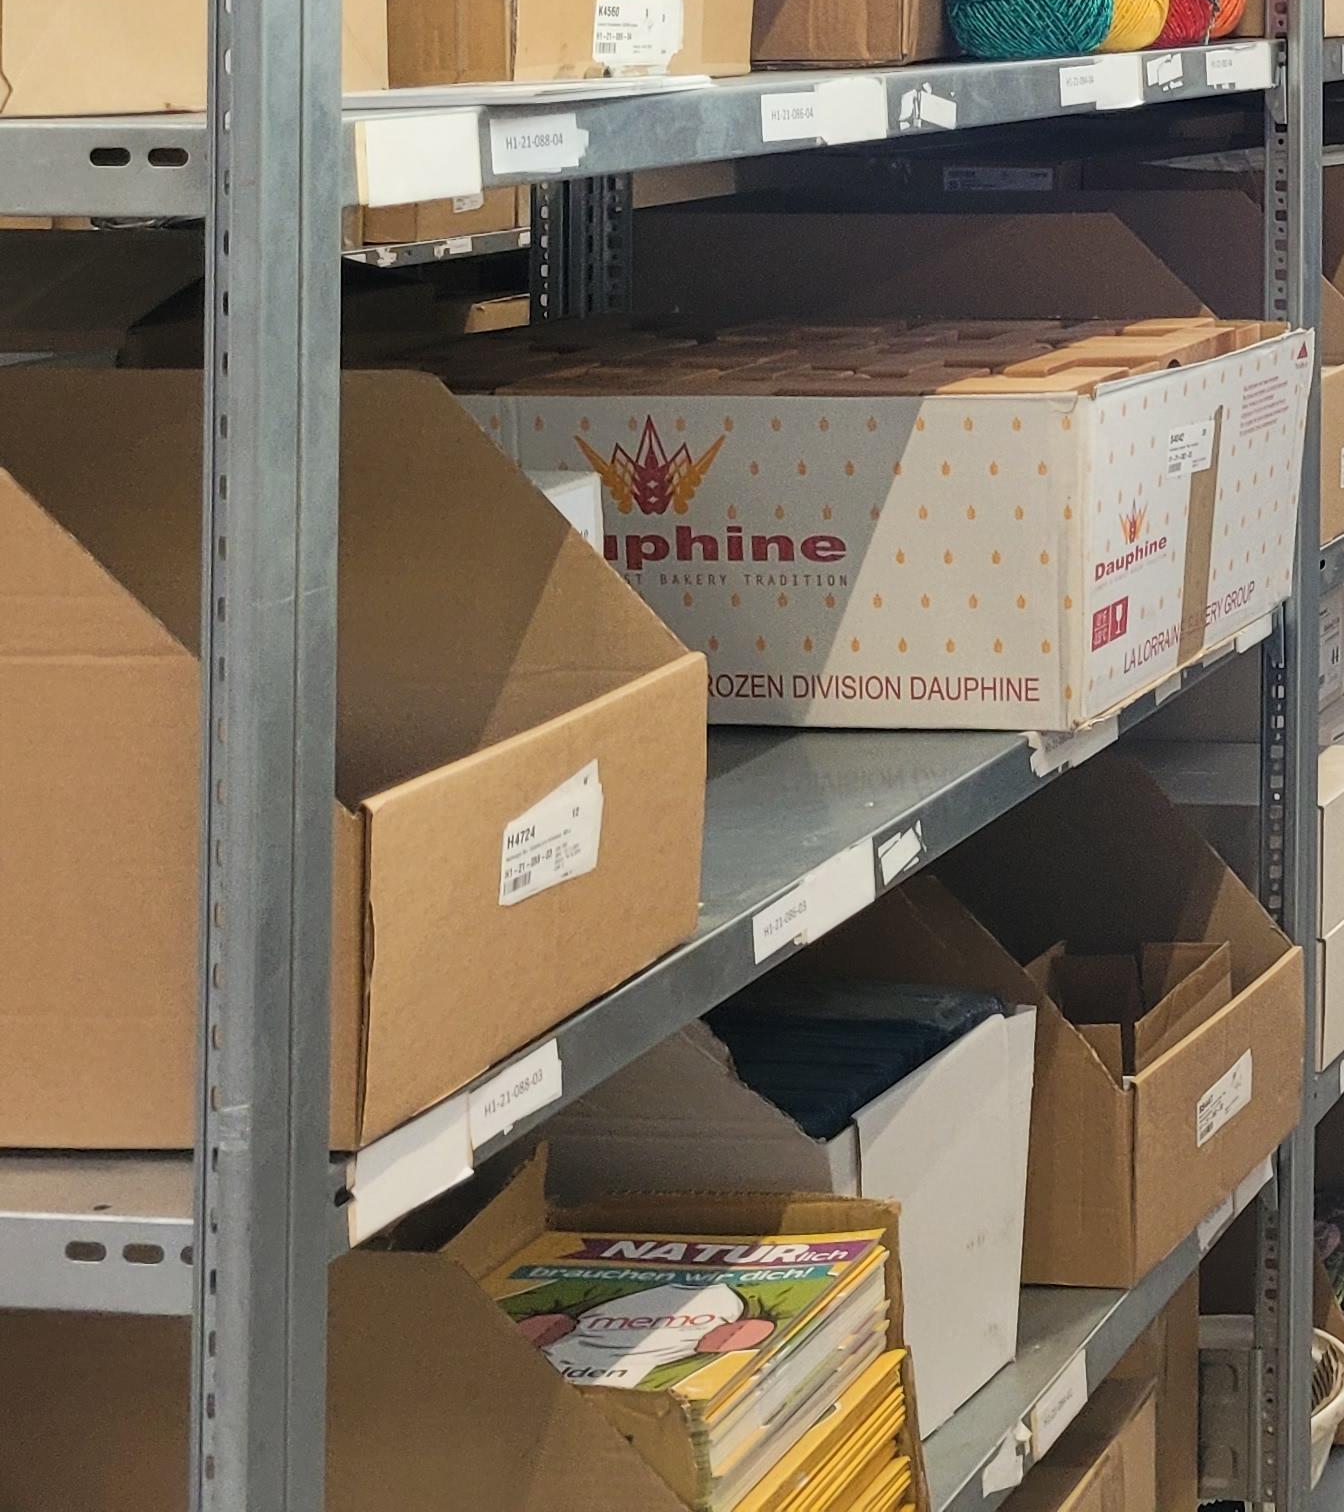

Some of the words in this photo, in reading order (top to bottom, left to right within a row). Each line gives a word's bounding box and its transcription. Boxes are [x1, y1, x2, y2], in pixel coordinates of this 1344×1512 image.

[504, 131, 565, 152] H1-21-088-04
[1093, 534, 1169, 582] Dauphine
[660, 573, 728, 586] BAKERY
[743, 573, 849, 587] TRADITION
[1223, 579, 1257, 618] GROUP
[792, 674, 902, 701] DIVISION
[909, 675, 1041, 703] DAUPHINE
[506, 824, 537, 850] H4724
[483, 1068, 544, 1118] H1-21-088-03
[528, 1265, 678, 1283] brauchen
[684, 1269, 738, 1285] wir
[739, 1265, 817, 1283] dich!
[588, 1312, 718, 1331] memo
